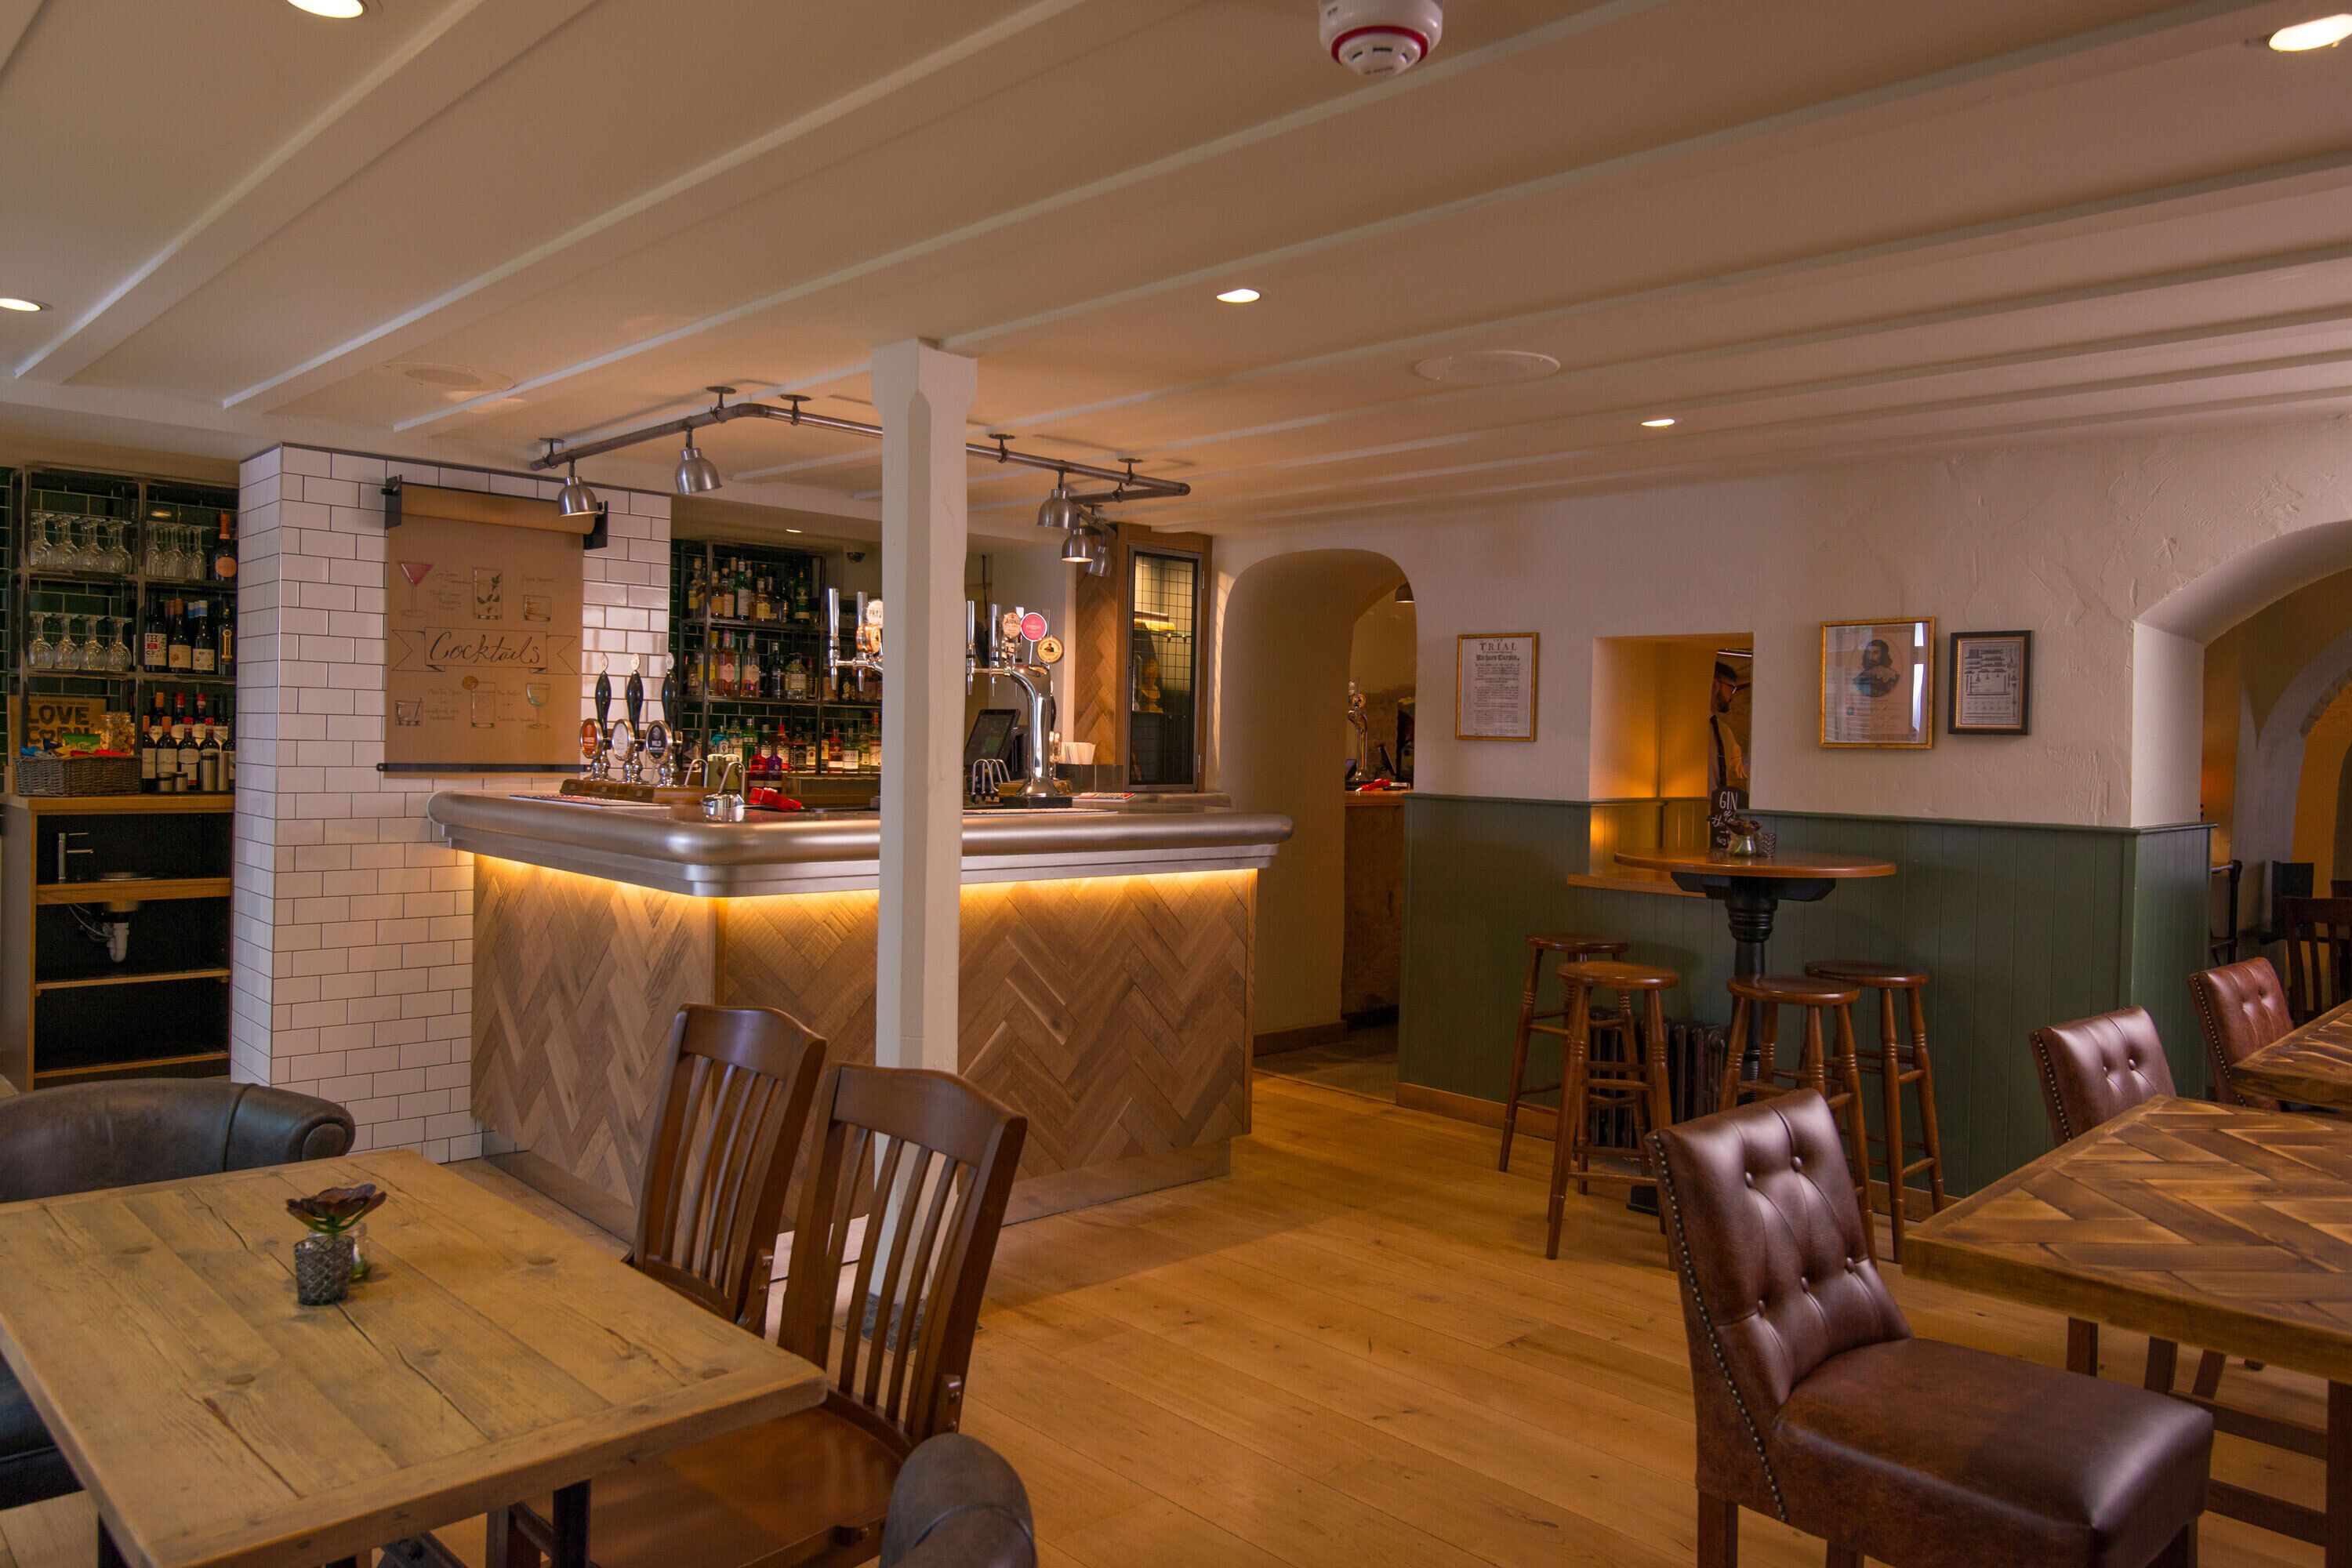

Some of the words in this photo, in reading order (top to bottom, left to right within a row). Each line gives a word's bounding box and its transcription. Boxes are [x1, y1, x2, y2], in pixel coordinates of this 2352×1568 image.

[430, 631, 539, 664] Cocktails
[1479, 642, 1517, 651] TRIAL
[1719, 790, 1738, 811] GIN
